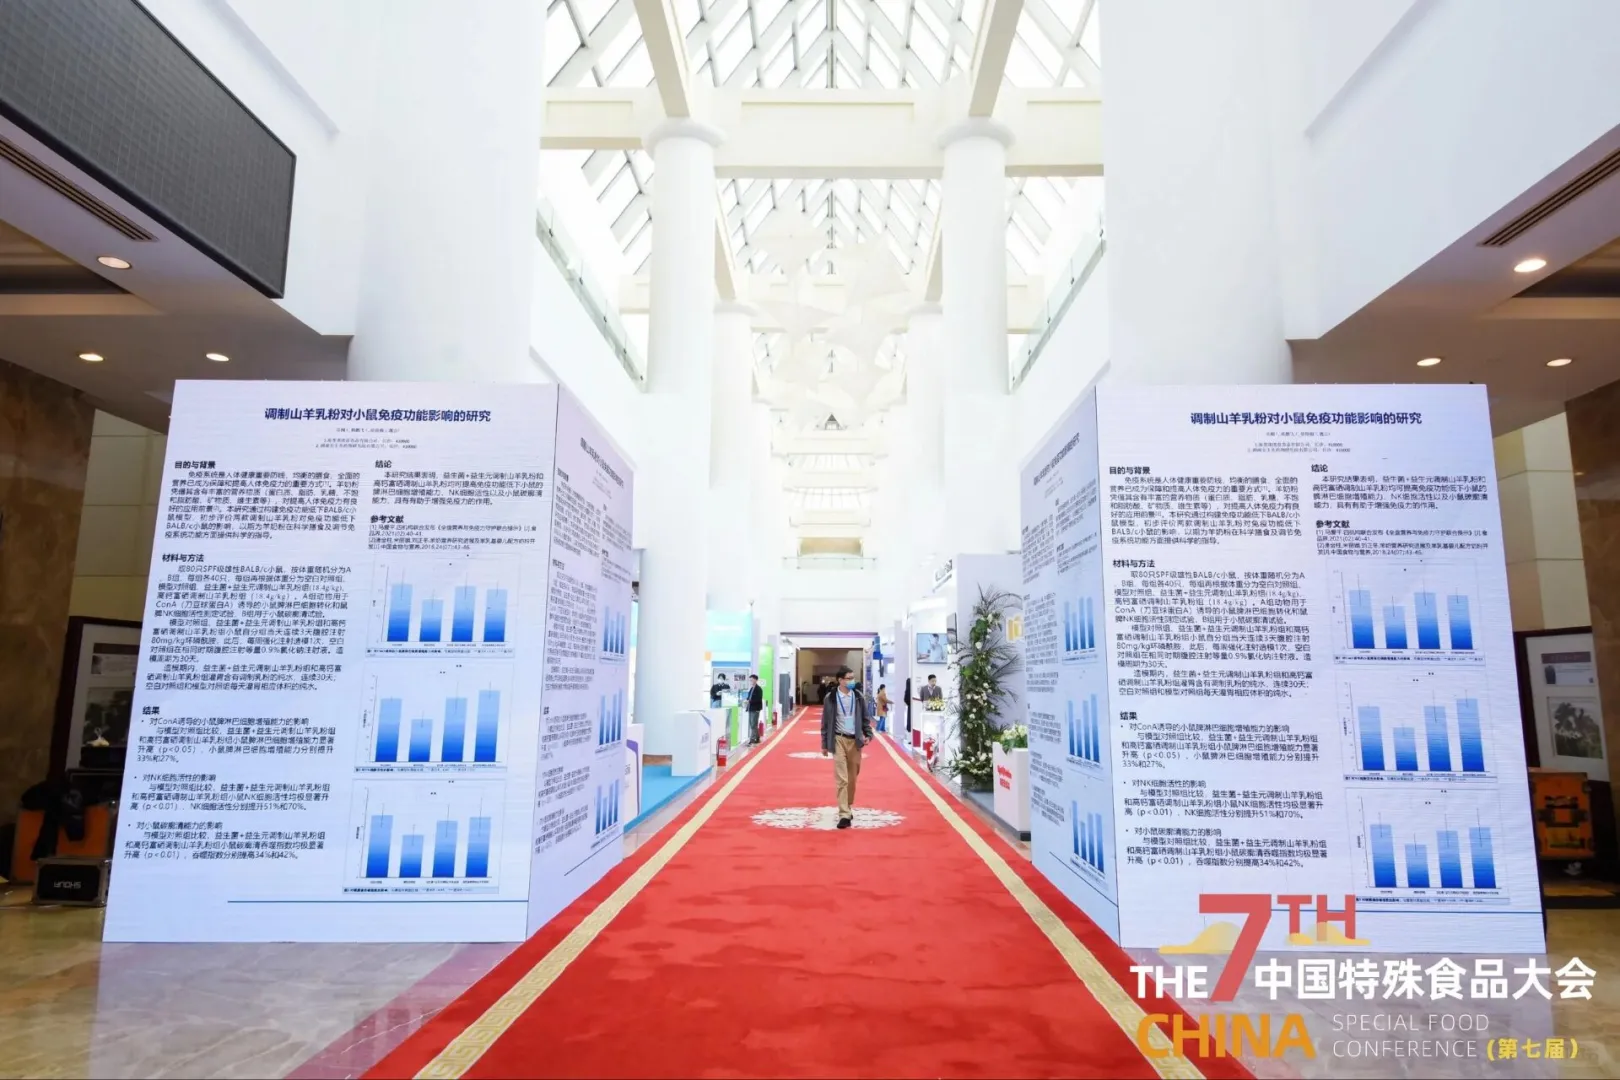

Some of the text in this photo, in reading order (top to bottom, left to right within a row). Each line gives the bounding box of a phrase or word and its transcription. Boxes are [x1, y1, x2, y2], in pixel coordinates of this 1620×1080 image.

[265, 408, 491, 422] 调制山羊乳粉对小鼠免疫功能影响的研究
[1190, 412, 1422, 425] 调制山羊乳粉对小鼠免疫功能影响的研究
[175, 461, 216, 469] 目的与背景
[375, 460, 392, 468] 结论
[1311, 464, 1328, 472] 结论
[370, 515, 404, 523] 参考文献
[1316, 520, 1350, 528] 参考文献
[162, 554, 204, 563] 材料与方法
[1112, 560, 1155, 568] 材料与方法
[142, 707, 160, 715] 结果
[1120, 712, 1138, 720] 结果
